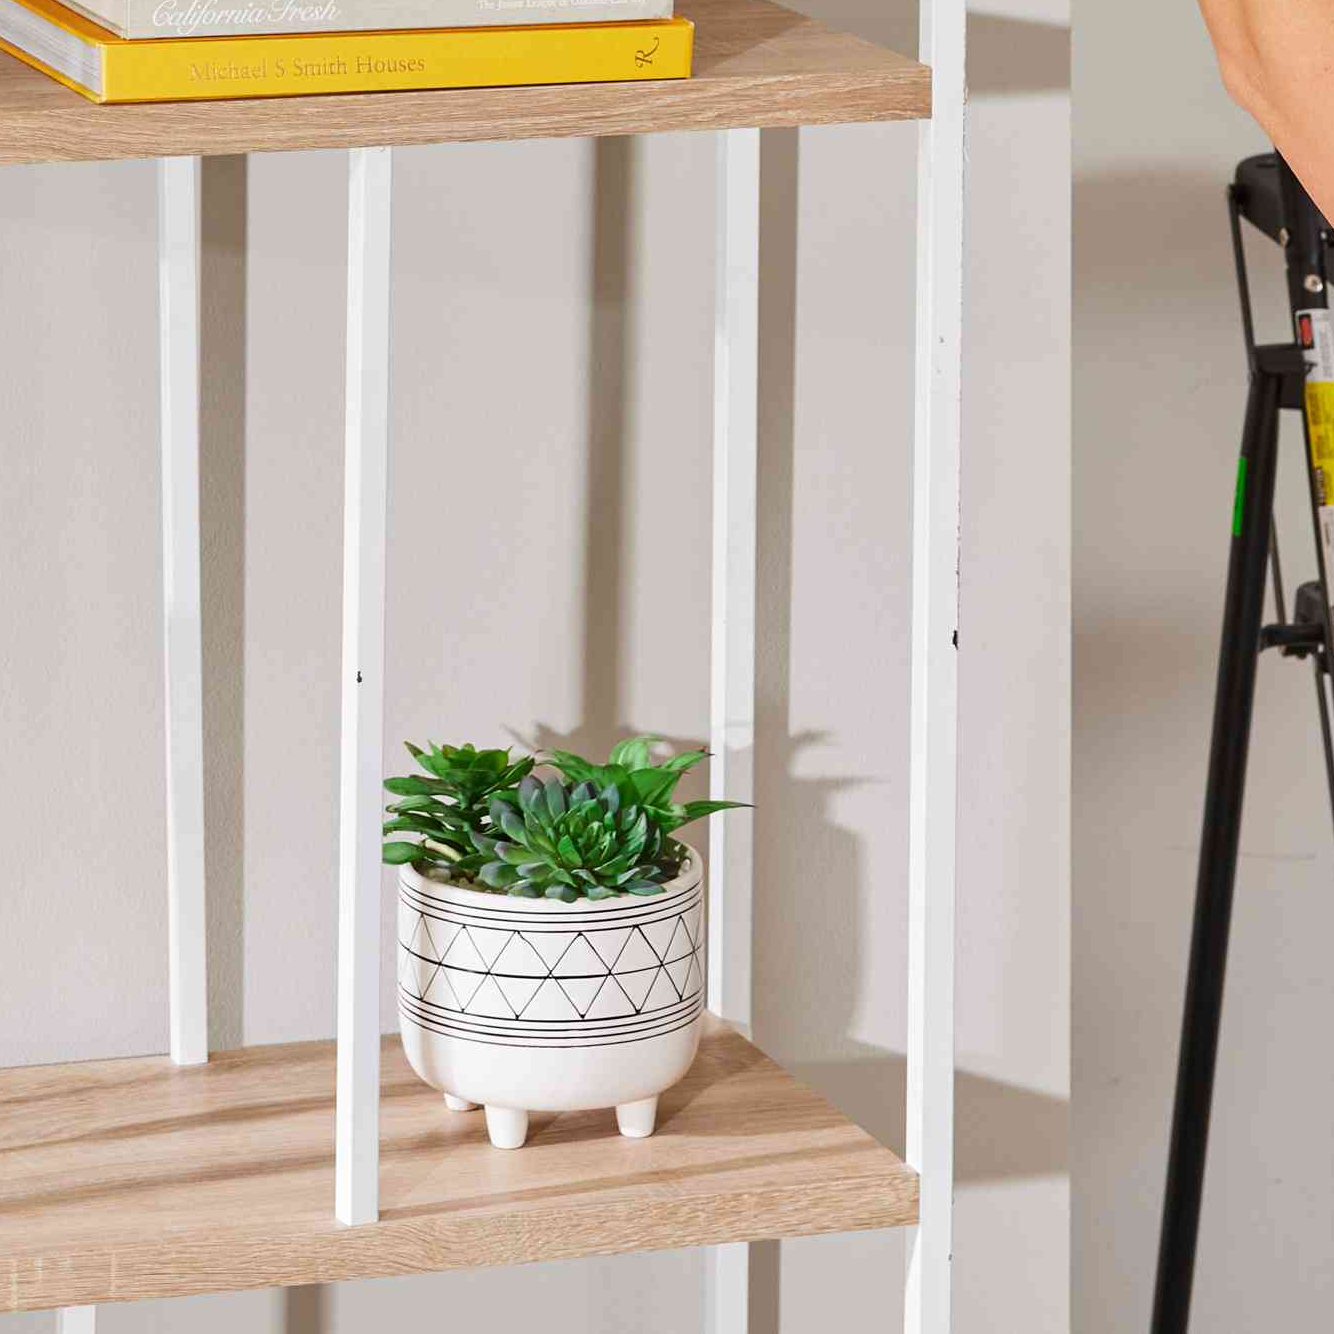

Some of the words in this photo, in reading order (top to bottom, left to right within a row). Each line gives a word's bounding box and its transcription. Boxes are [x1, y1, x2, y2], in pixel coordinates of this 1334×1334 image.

[190, 57, 267, 81] Michael
[275, 59, 286, 79] S
[293, 55, 348, 78] Smith
[355, 55, 426, 74] Houses
